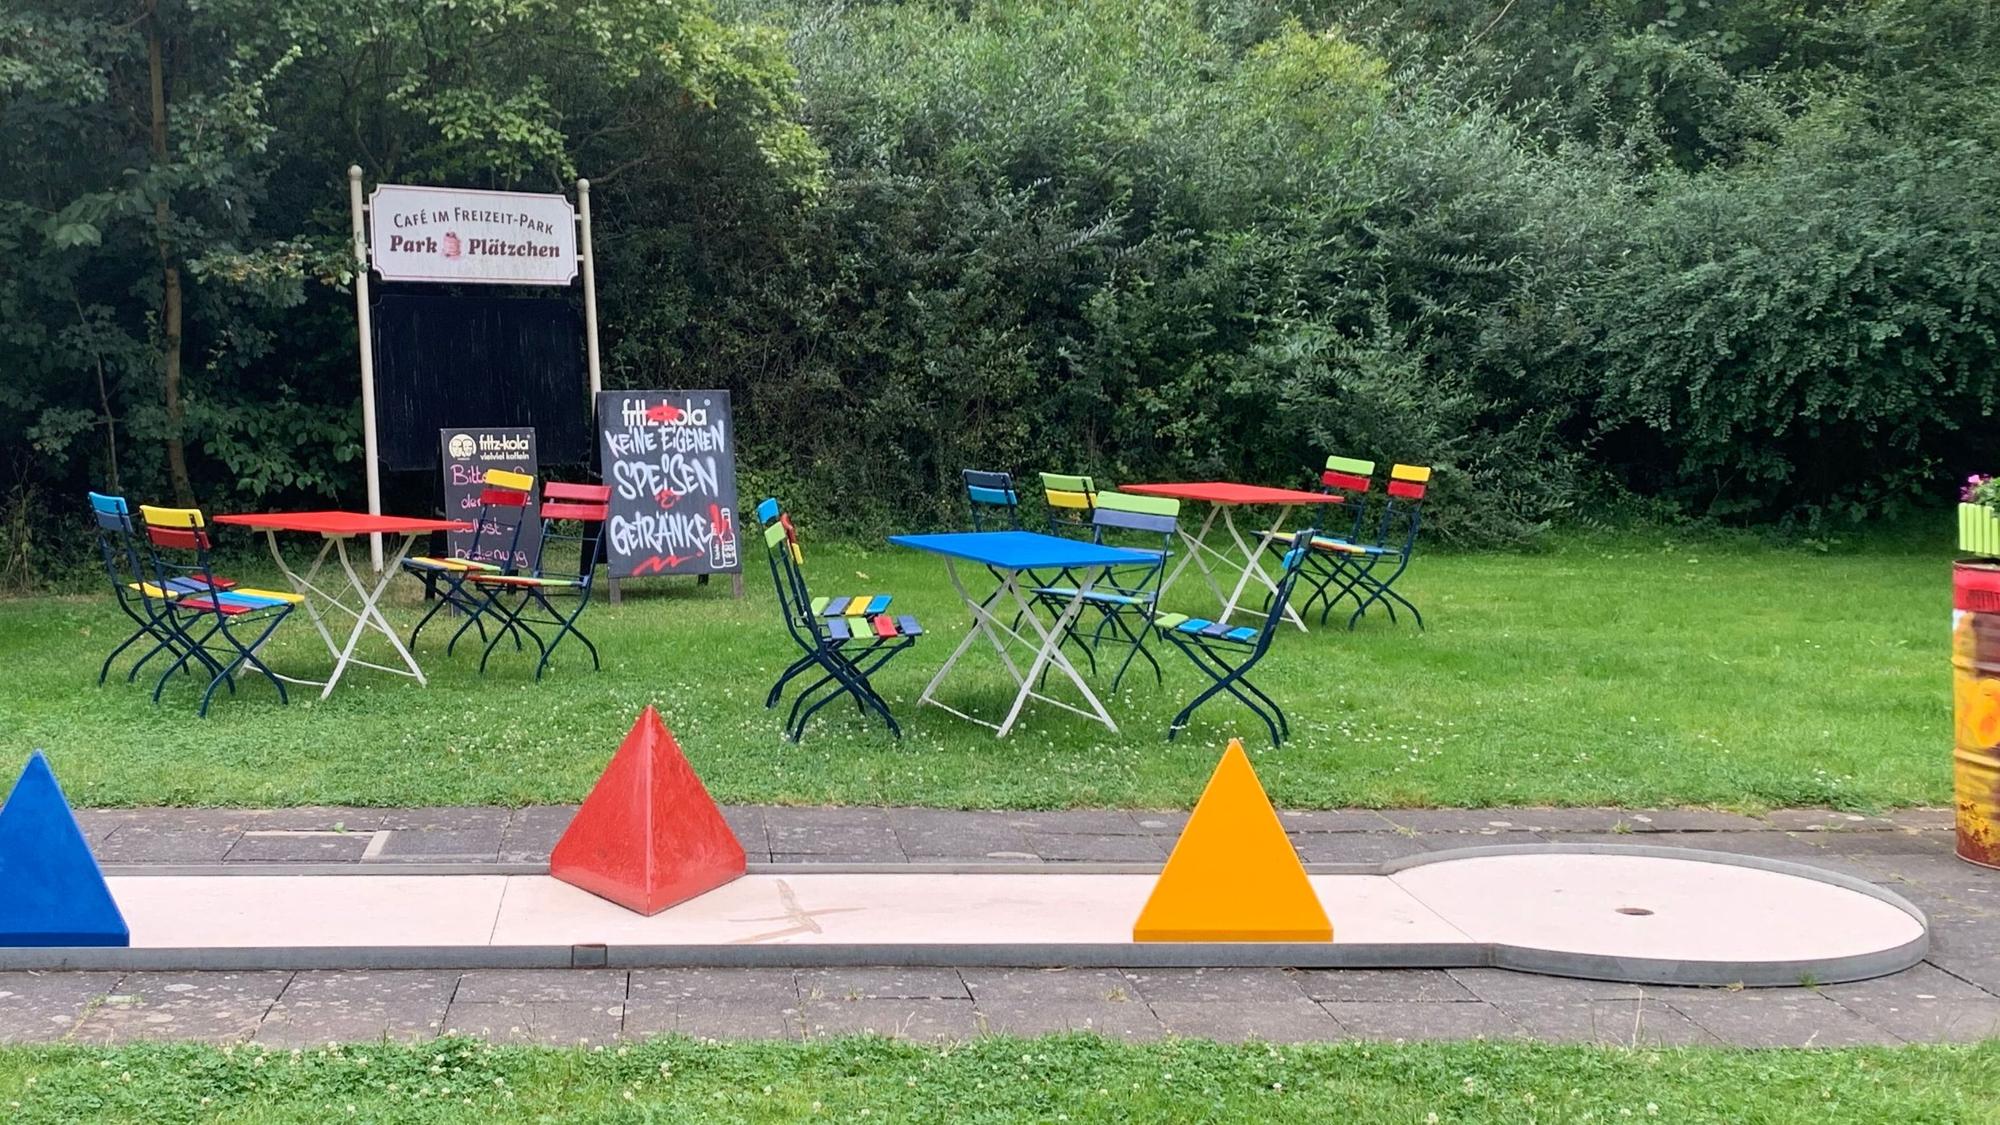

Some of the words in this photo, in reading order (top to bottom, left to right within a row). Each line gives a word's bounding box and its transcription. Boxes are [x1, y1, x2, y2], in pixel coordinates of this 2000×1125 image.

[394, 209, 428, 228] CAFÉ
[433, 210, 449, 223] IM
[455, 207, 554, 235] FREIZEIT-PARK
[389, 235, 437, 253] Park
[469, 238, 560, 258] Plätzchen
[479, 434, 529, 450] fritz-kola
